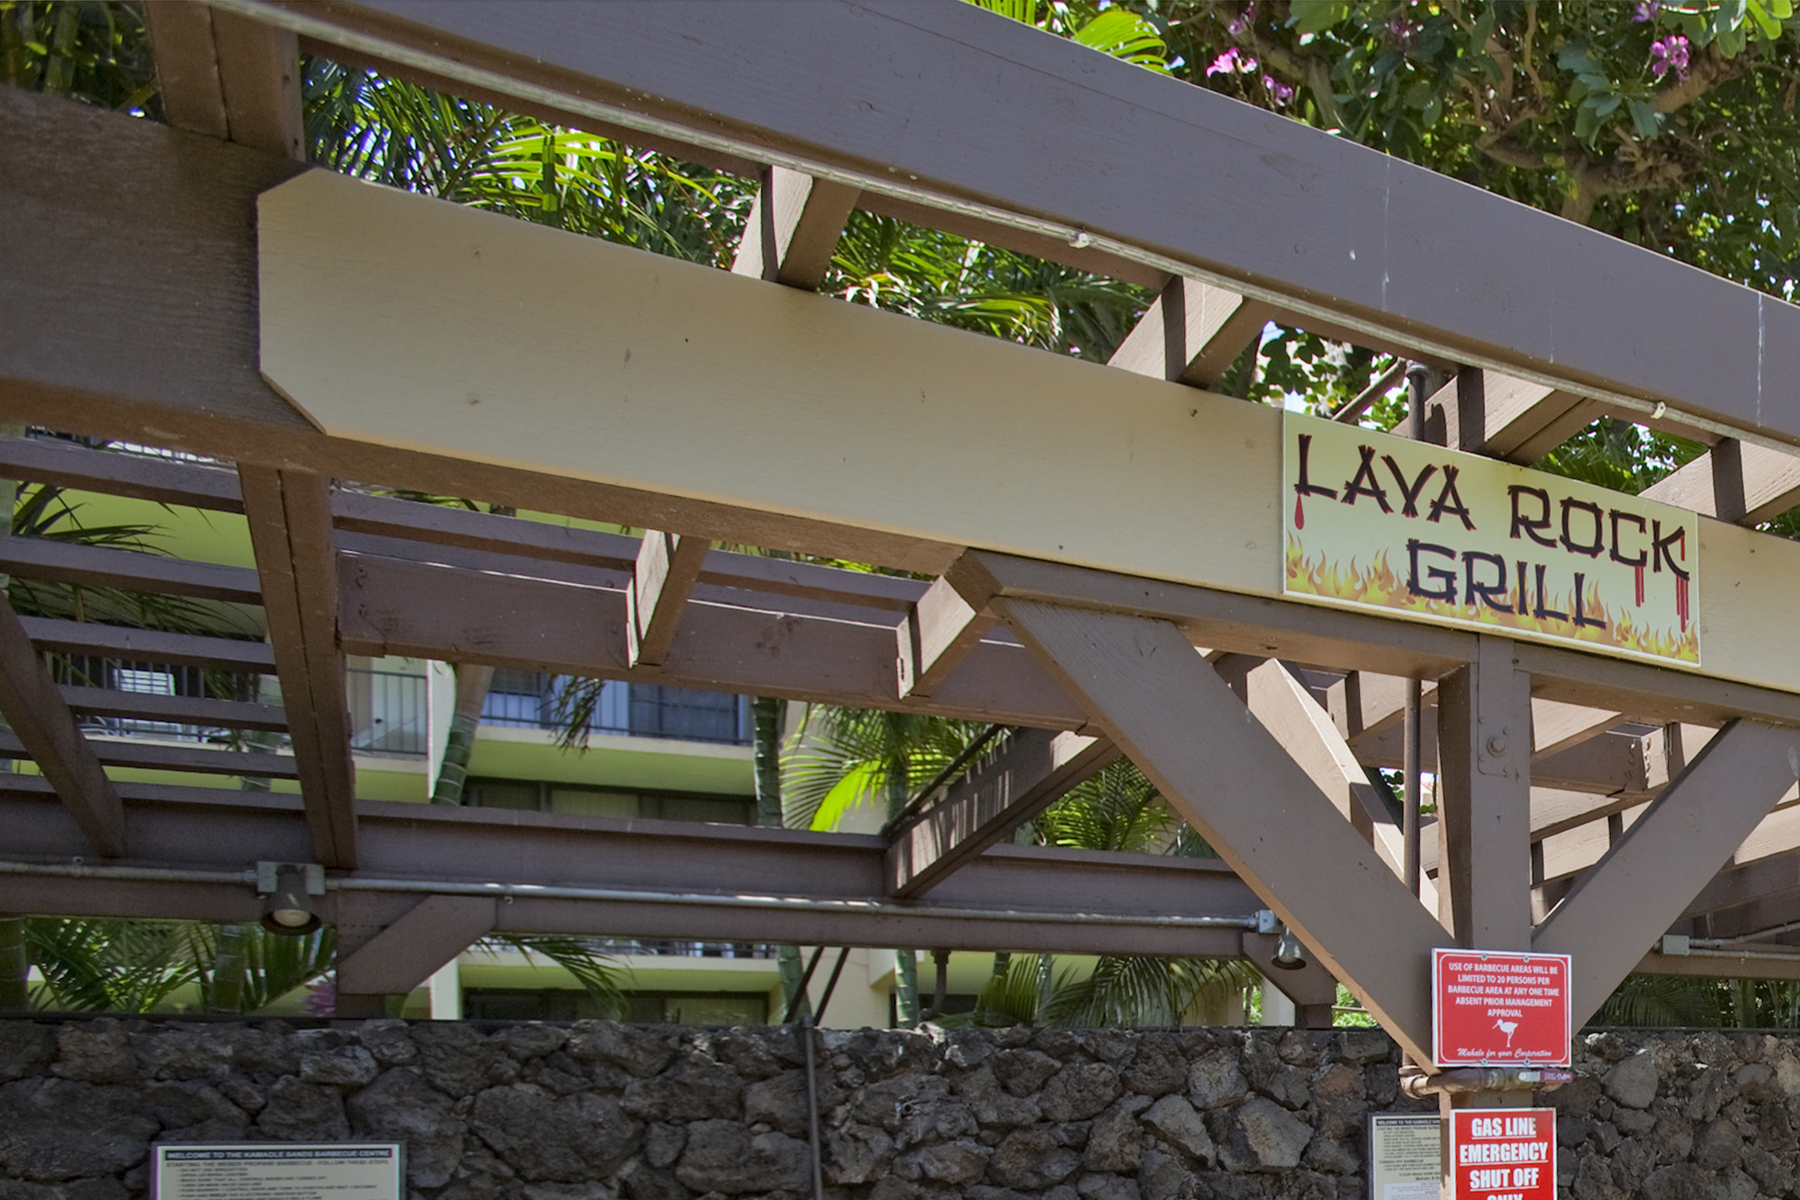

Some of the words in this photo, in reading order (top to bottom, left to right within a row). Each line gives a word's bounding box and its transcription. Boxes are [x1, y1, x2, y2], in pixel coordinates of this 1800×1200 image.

[1293, 433, 1477, 531] LAVA
[1507, 483, 1690, 581] ROCK
[1405, 537, 1607, 629] GRILL
[1449, 962, 1462, 971] USE
[1463, 963, 1473, 971] OF
[1474, 963, 1510, 973] BARBECUE
[1510, 965, 1532, 974] AREAS
[1532, 966, 1549, 974] WILL
[1549, 966, 1558, 975] BE
[1458, 974, 1486, 983] LIMITED
[1486, 975, 1496, 983] TO
[1497, 975, 1506, 984] 20
[1506, 975, 1537, 985] PERSONS
[1537, 977, 1550, 985] PER
[1448, 985, 1484, 994] BARBECUE
[1485, 986, 1503, 995] AREA
[1504, 987, 1513, 995] AT
[1513, 987, 1528, 995] ANY
[1528, 987, 1543, 996] ONE
[1543, 988, 1559, 996] TIME
[1455, 996, 1483, 1005] ABSENT
[1483, 997, 1504, 1006] PRIOR
[1505, 998, 1553, 1007] MANAGEMENT
[1487, 1008, 1523, 1017] APPROVAL
[1457, 1047, 1485, 1057] Mahalo
[1486, 1049, 1496, 1058] for
[1514, 1048, 1552, 1059] Cooperation
[1471, 1118, 1502, 1136] GAS
[1505, 1117, 1537, 1135] LINE
[1460, 1142, 1548, 1162] EMERGENCY
[1469, 1169, 1511, 1188] SHUT
[1513, 1168, 1540, 1187] OFF
